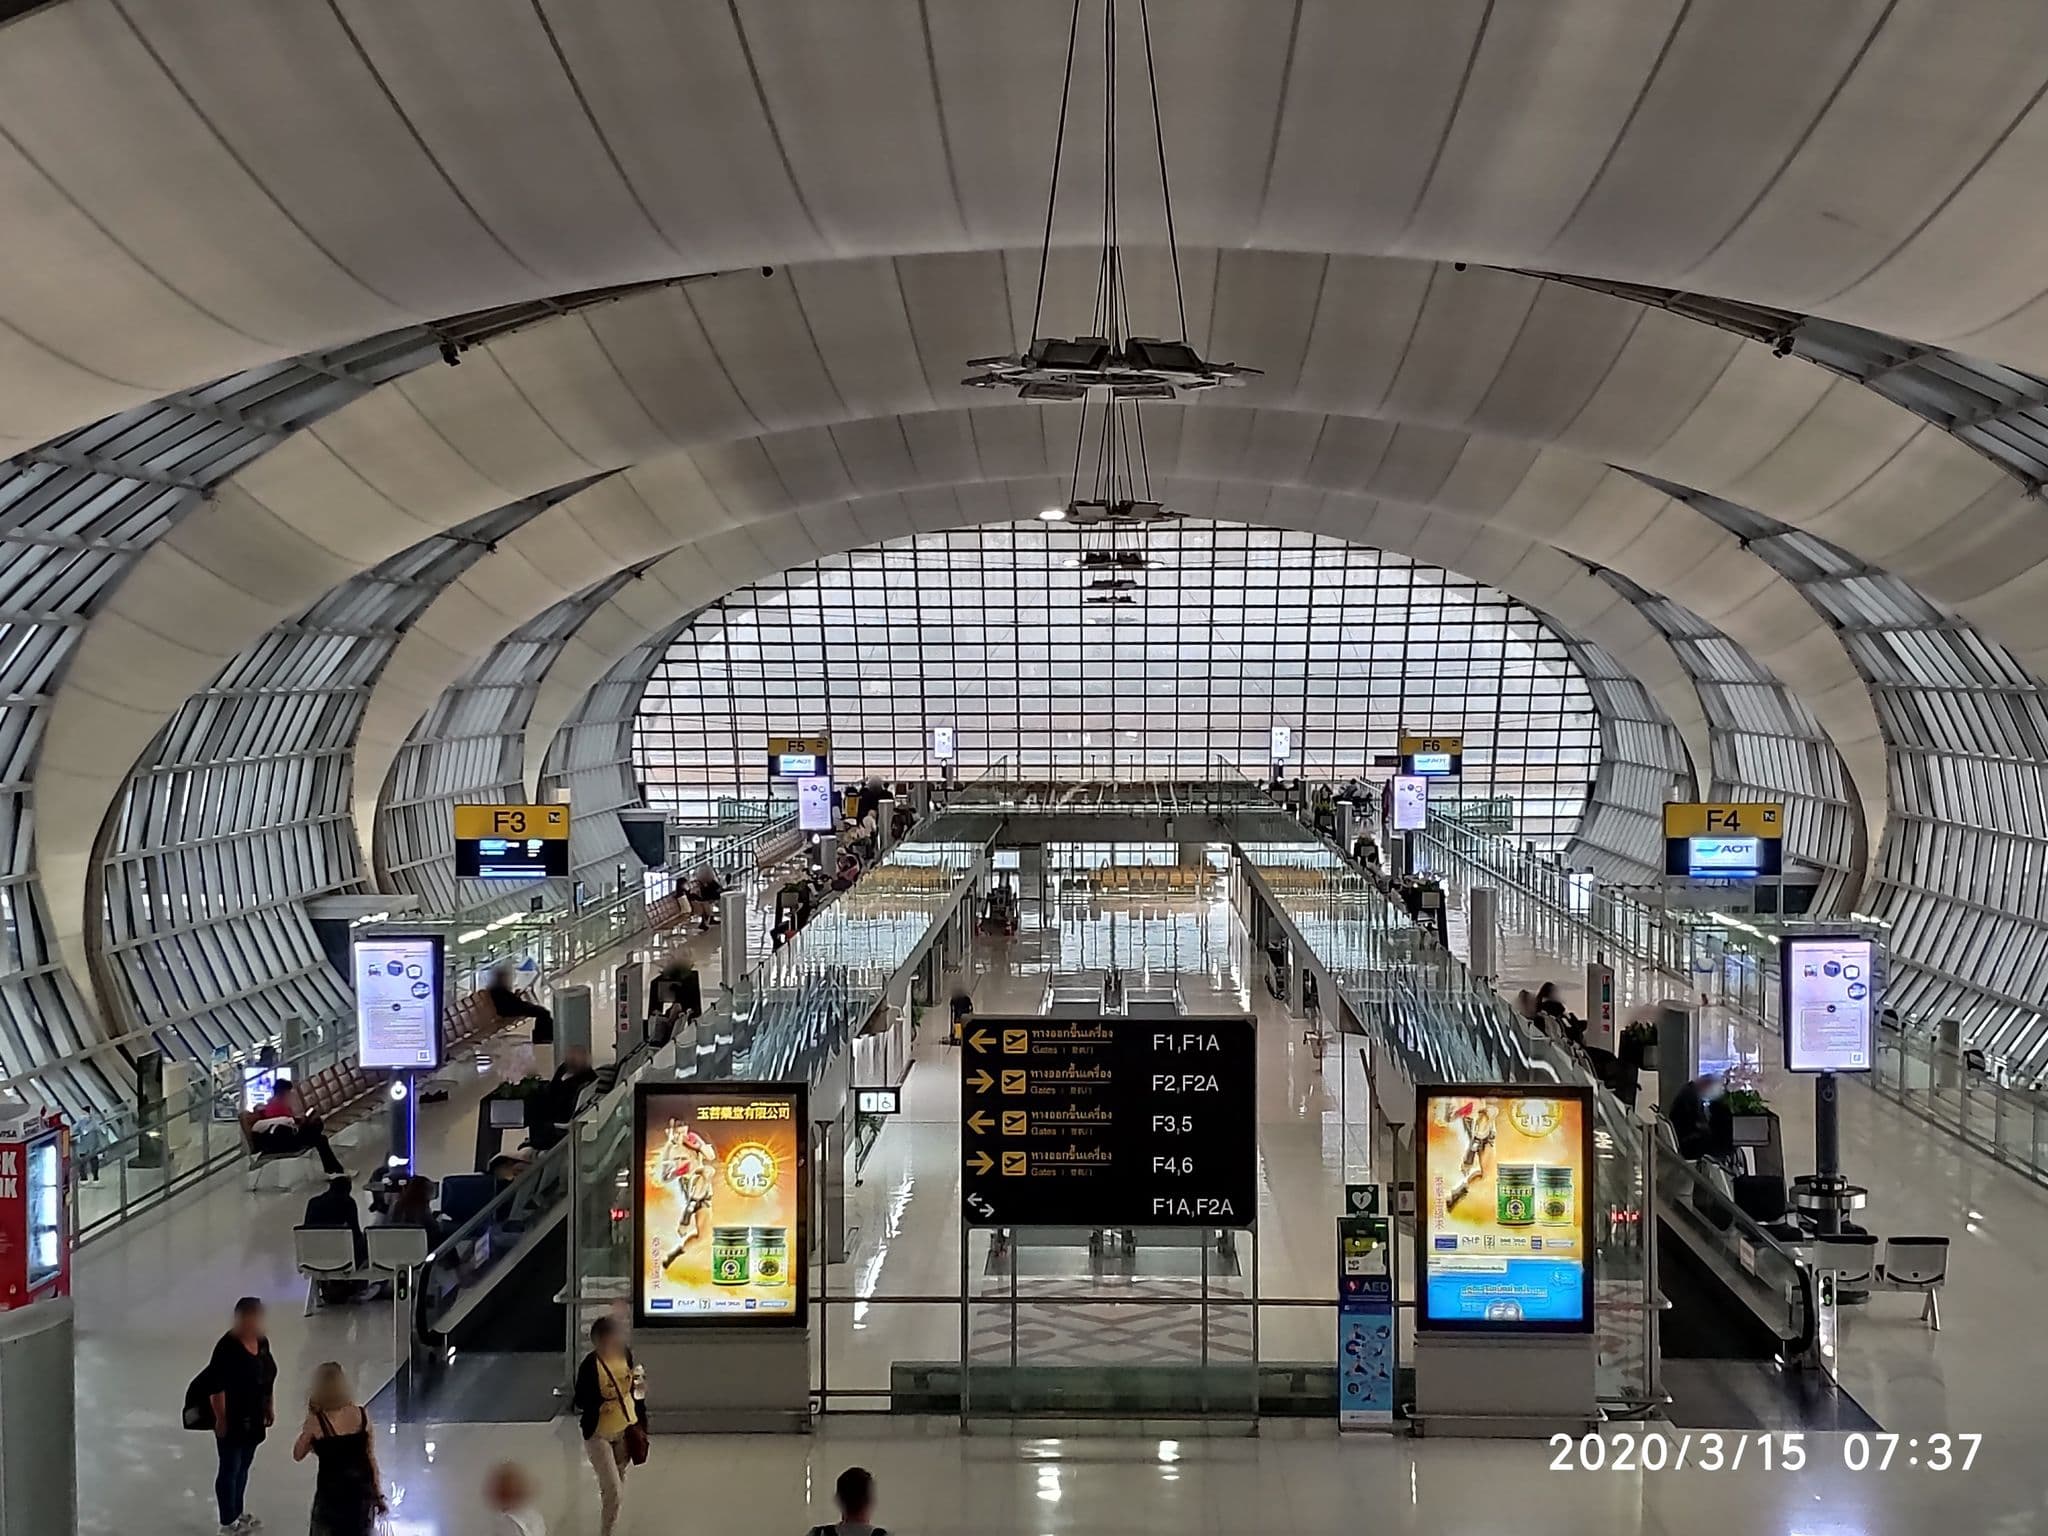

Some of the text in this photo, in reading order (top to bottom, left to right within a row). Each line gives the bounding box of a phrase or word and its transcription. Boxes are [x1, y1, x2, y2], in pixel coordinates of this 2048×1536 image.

[788, 740, 805, 752] F5
[1423, 739, 1440, 751] F6
[494, 811, 526, 832] F3
[1707, 810, 1741, 831] F4
[1721, 845, 1752, 853] AOT
[1153, 1033, 1220, 1053] F1,F1A
[1152, 1075, 1219, 1094] F2,F2A
[1152, 1115, 1193, 1135] F3,5
[1153, 1156, 1193, 1176] F4,6
[1153, 1198, 1234, 1217] F1A,F2A
[1363, 1282, 1389, 1292] AED
